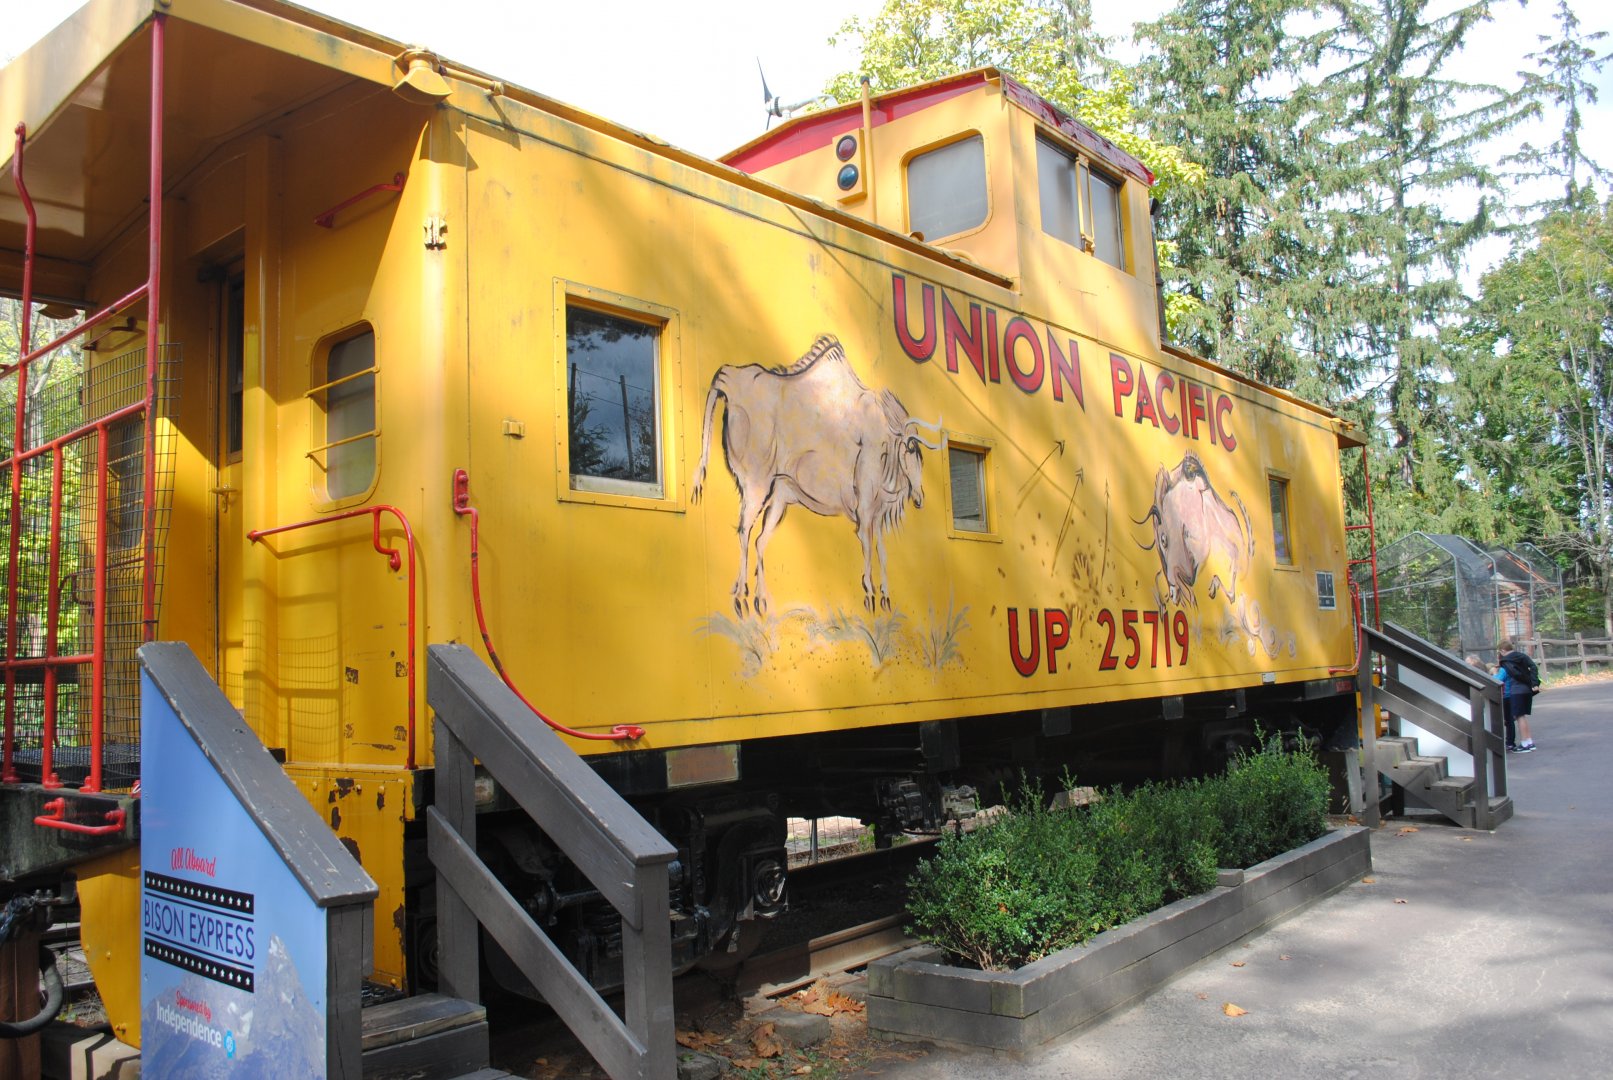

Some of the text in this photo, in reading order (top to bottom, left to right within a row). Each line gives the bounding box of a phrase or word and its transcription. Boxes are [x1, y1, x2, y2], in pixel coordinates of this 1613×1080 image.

[892, 273, 1237, 452] UNION PACIFIC
[1007, 608, 1189, 678] UP 25719
[171, 847, 216, 878] All Aboard
[144, 899, 255, 960] BISON EXPRESS
[157, 1001, 222, 1048] Independence
